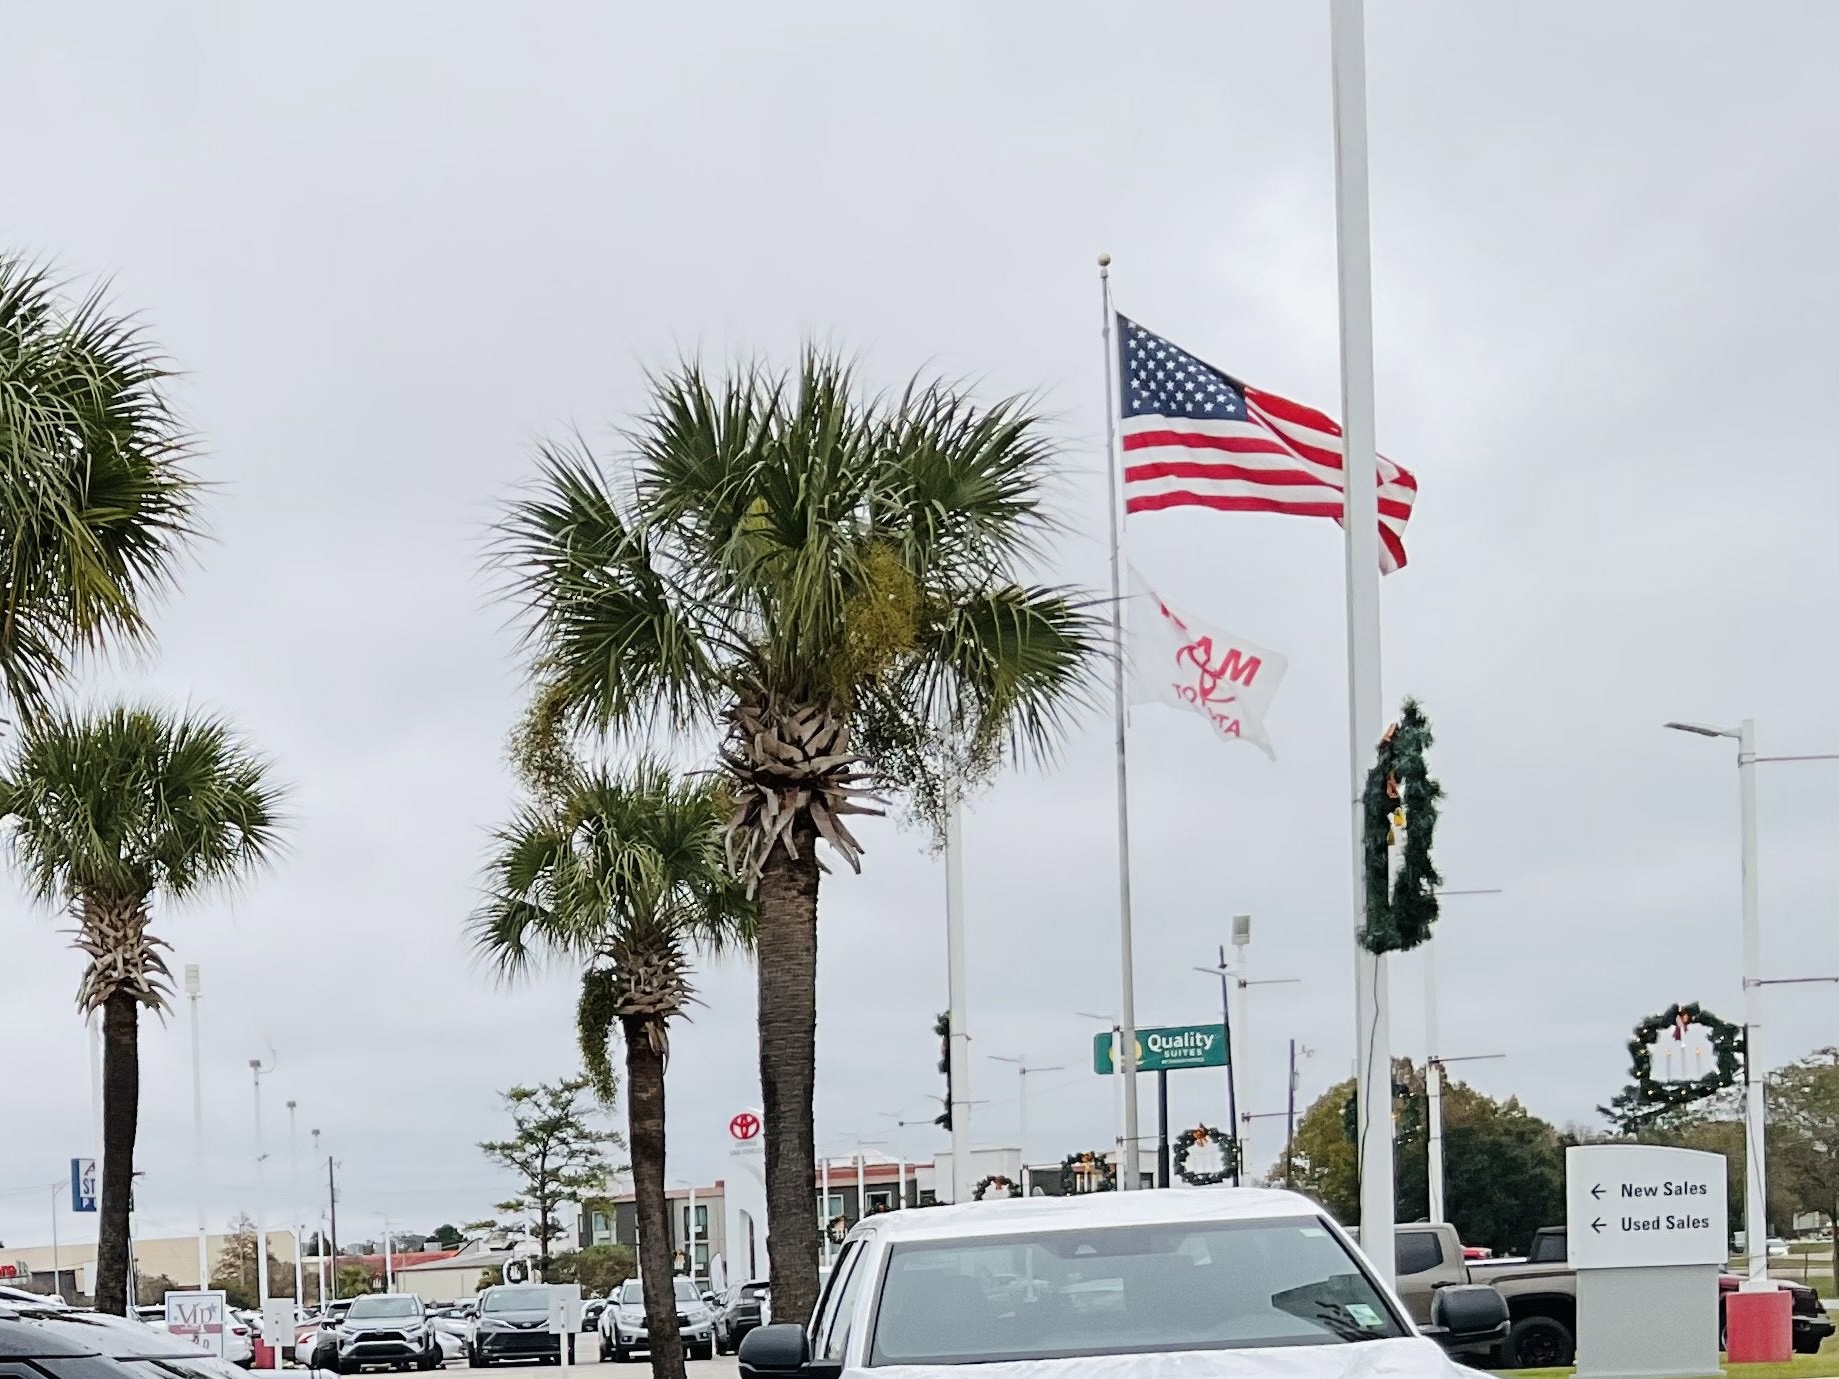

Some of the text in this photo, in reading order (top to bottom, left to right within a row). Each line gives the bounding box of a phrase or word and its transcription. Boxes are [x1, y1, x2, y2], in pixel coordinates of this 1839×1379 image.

[1171, 683, 1241, 738] TOTA
[1147, 1031, 1214, 1053] Quality
[1163, 1048, 1203, 1058] SUITES
[1621, 1181, 1707, 1198] New Sales
[1621, 1214, 1709, 1231] Used Sales
